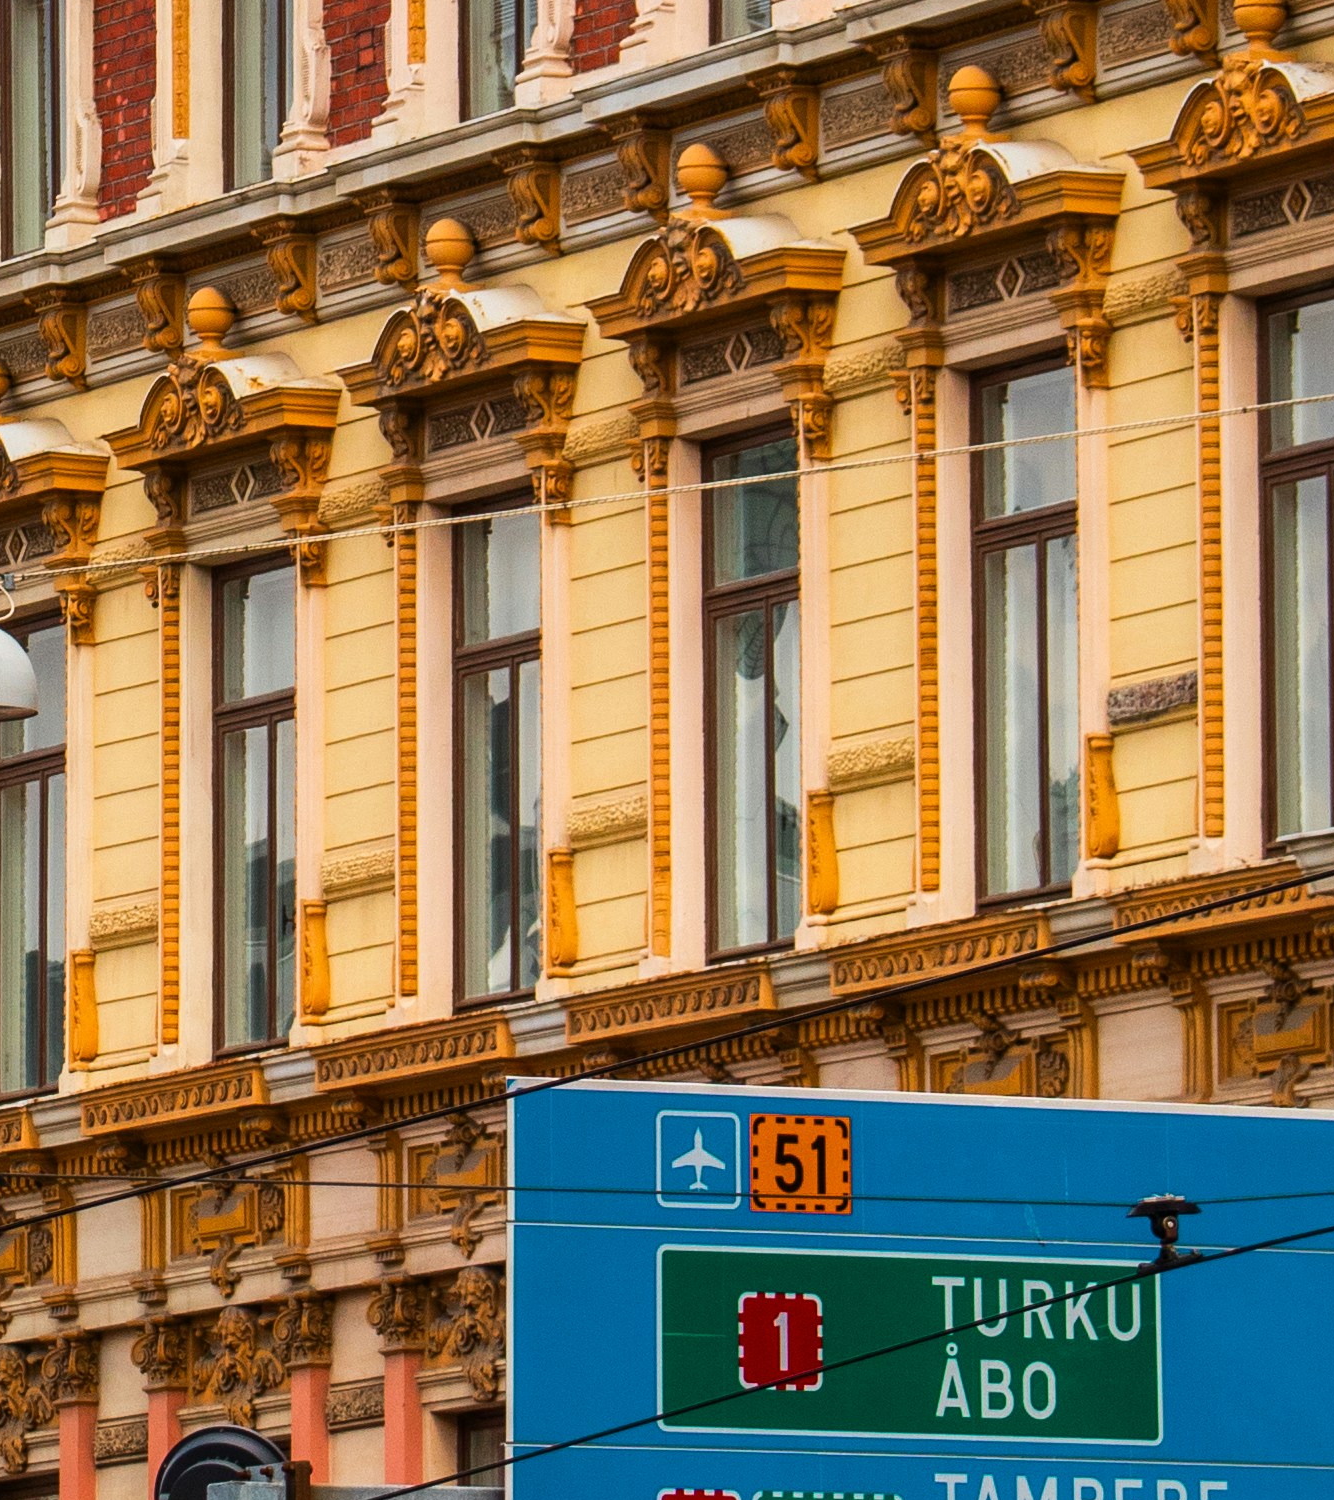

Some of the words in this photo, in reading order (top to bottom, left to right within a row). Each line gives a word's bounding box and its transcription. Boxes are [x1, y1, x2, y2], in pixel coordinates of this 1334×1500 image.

[774, 1133, 827, 1195] 51
[932, 1276, 1142, 1342] TURKU
[773, 1312, 790, 1371] 1
[935, 1342, 1057, 1420] ÅBO
